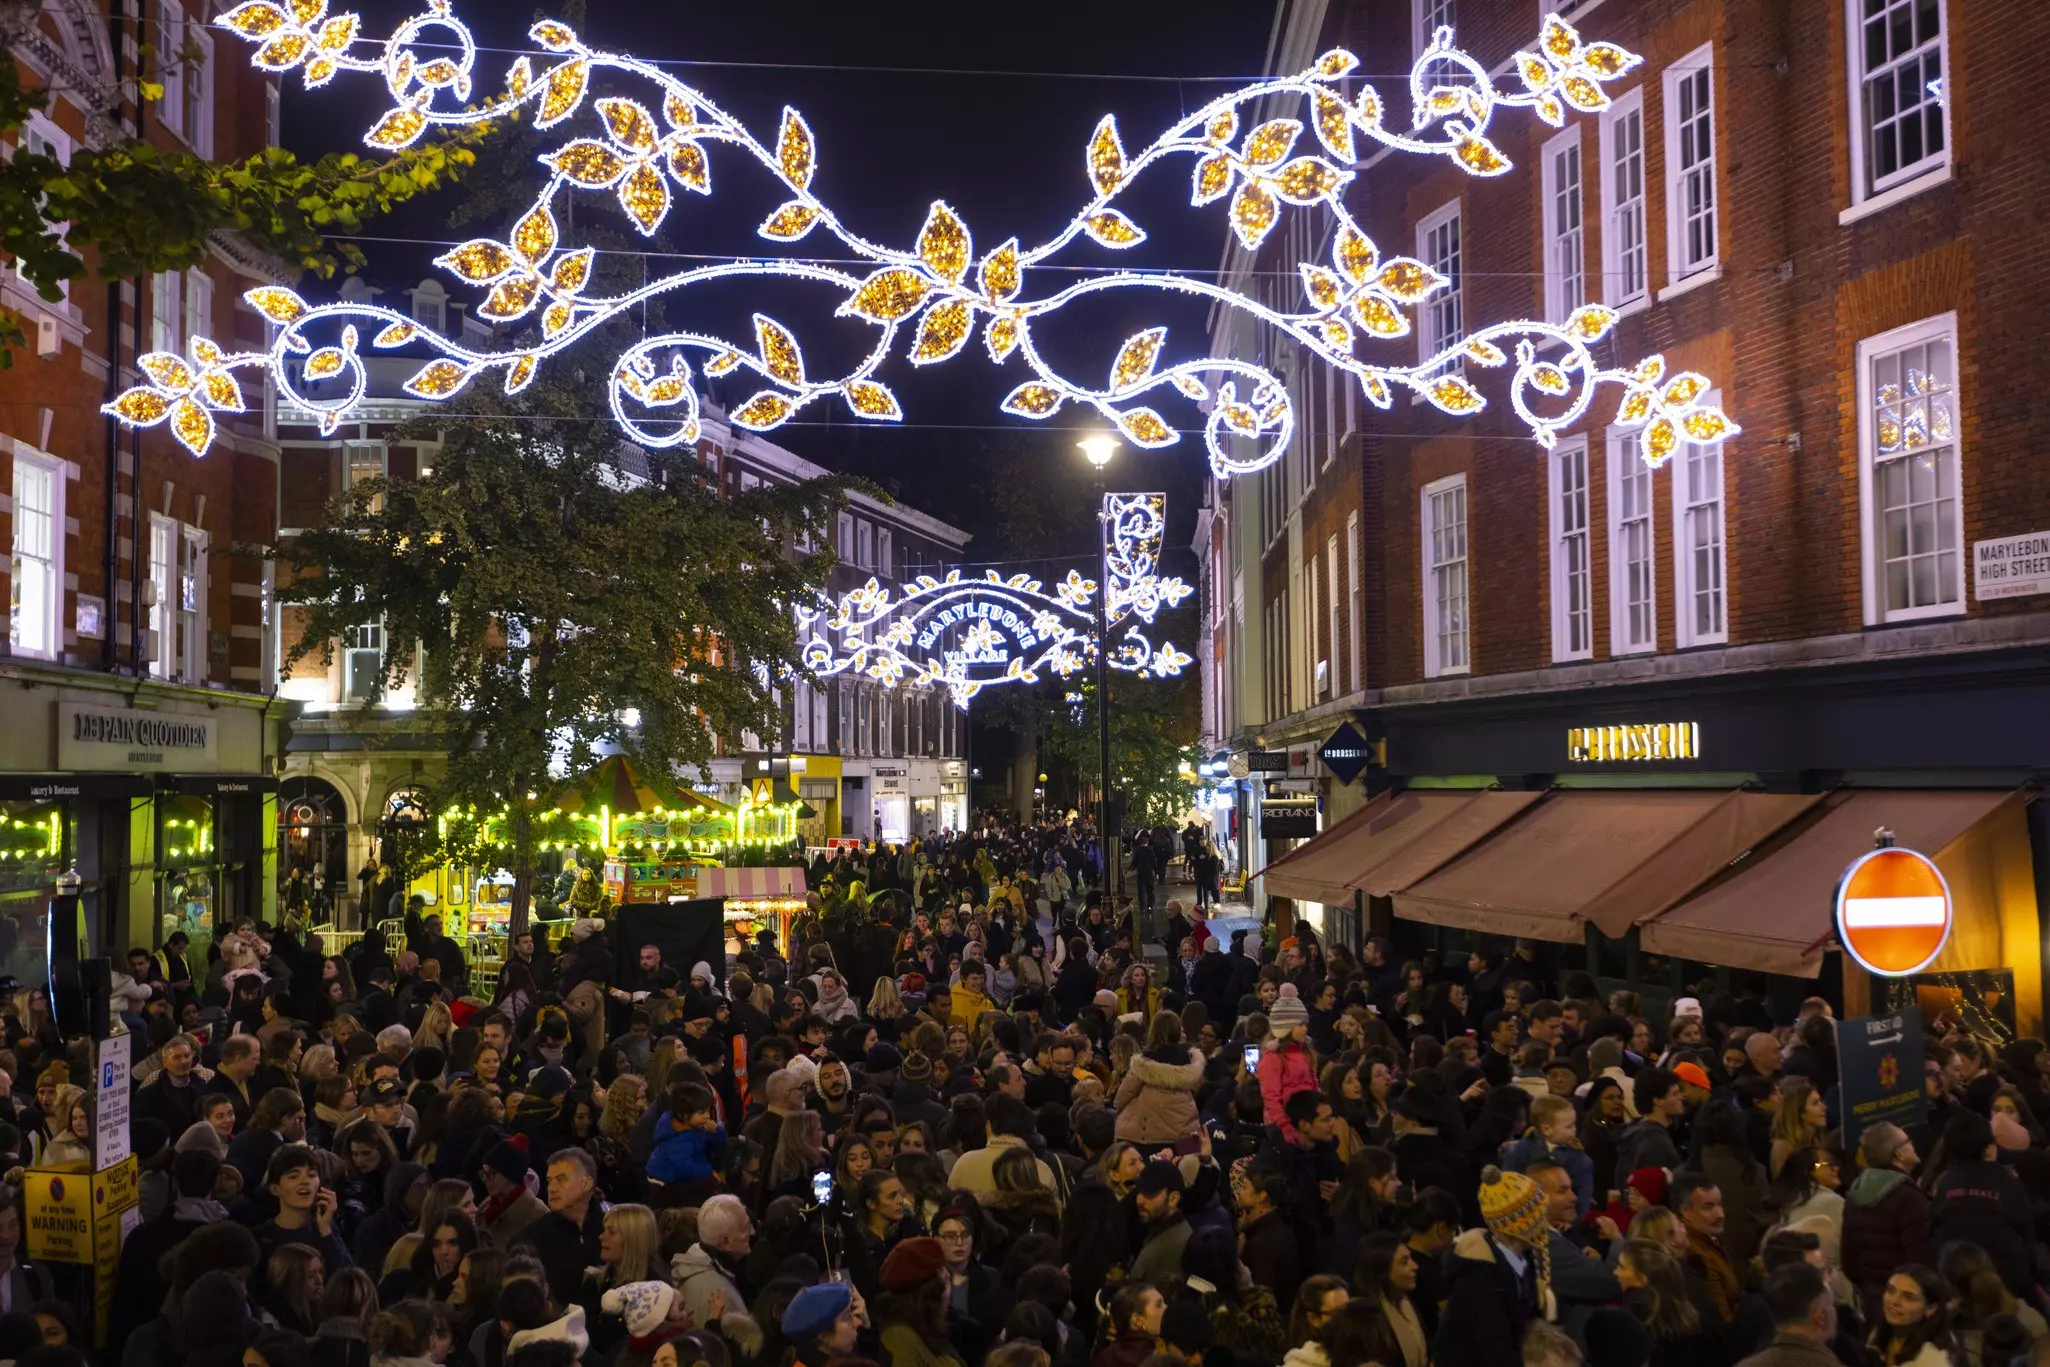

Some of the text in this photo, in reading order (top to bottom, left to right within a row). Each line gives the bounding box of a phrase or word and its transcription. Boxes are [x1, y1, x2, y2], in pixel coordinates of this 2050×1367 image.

[1981, 562, 2007, 580] HIGH
[916, 601, 1037, 650] MARYLEBONE
[944, 649, 1008, 664] VILLAGE
[75, 713, 207, 748] LE PAIN QUOTIDIEN
[1250, 755, 1286, 769] TOAST
[1262, 808, 1315, 817] FABRIANO
[1866, 1020, 1891, 1034] FIRST
[107, 1163, 129, 1185] NOTICE
[31, 1215, 87, 1234] WARNING
[46, 1234, 73, 1248] Parking
